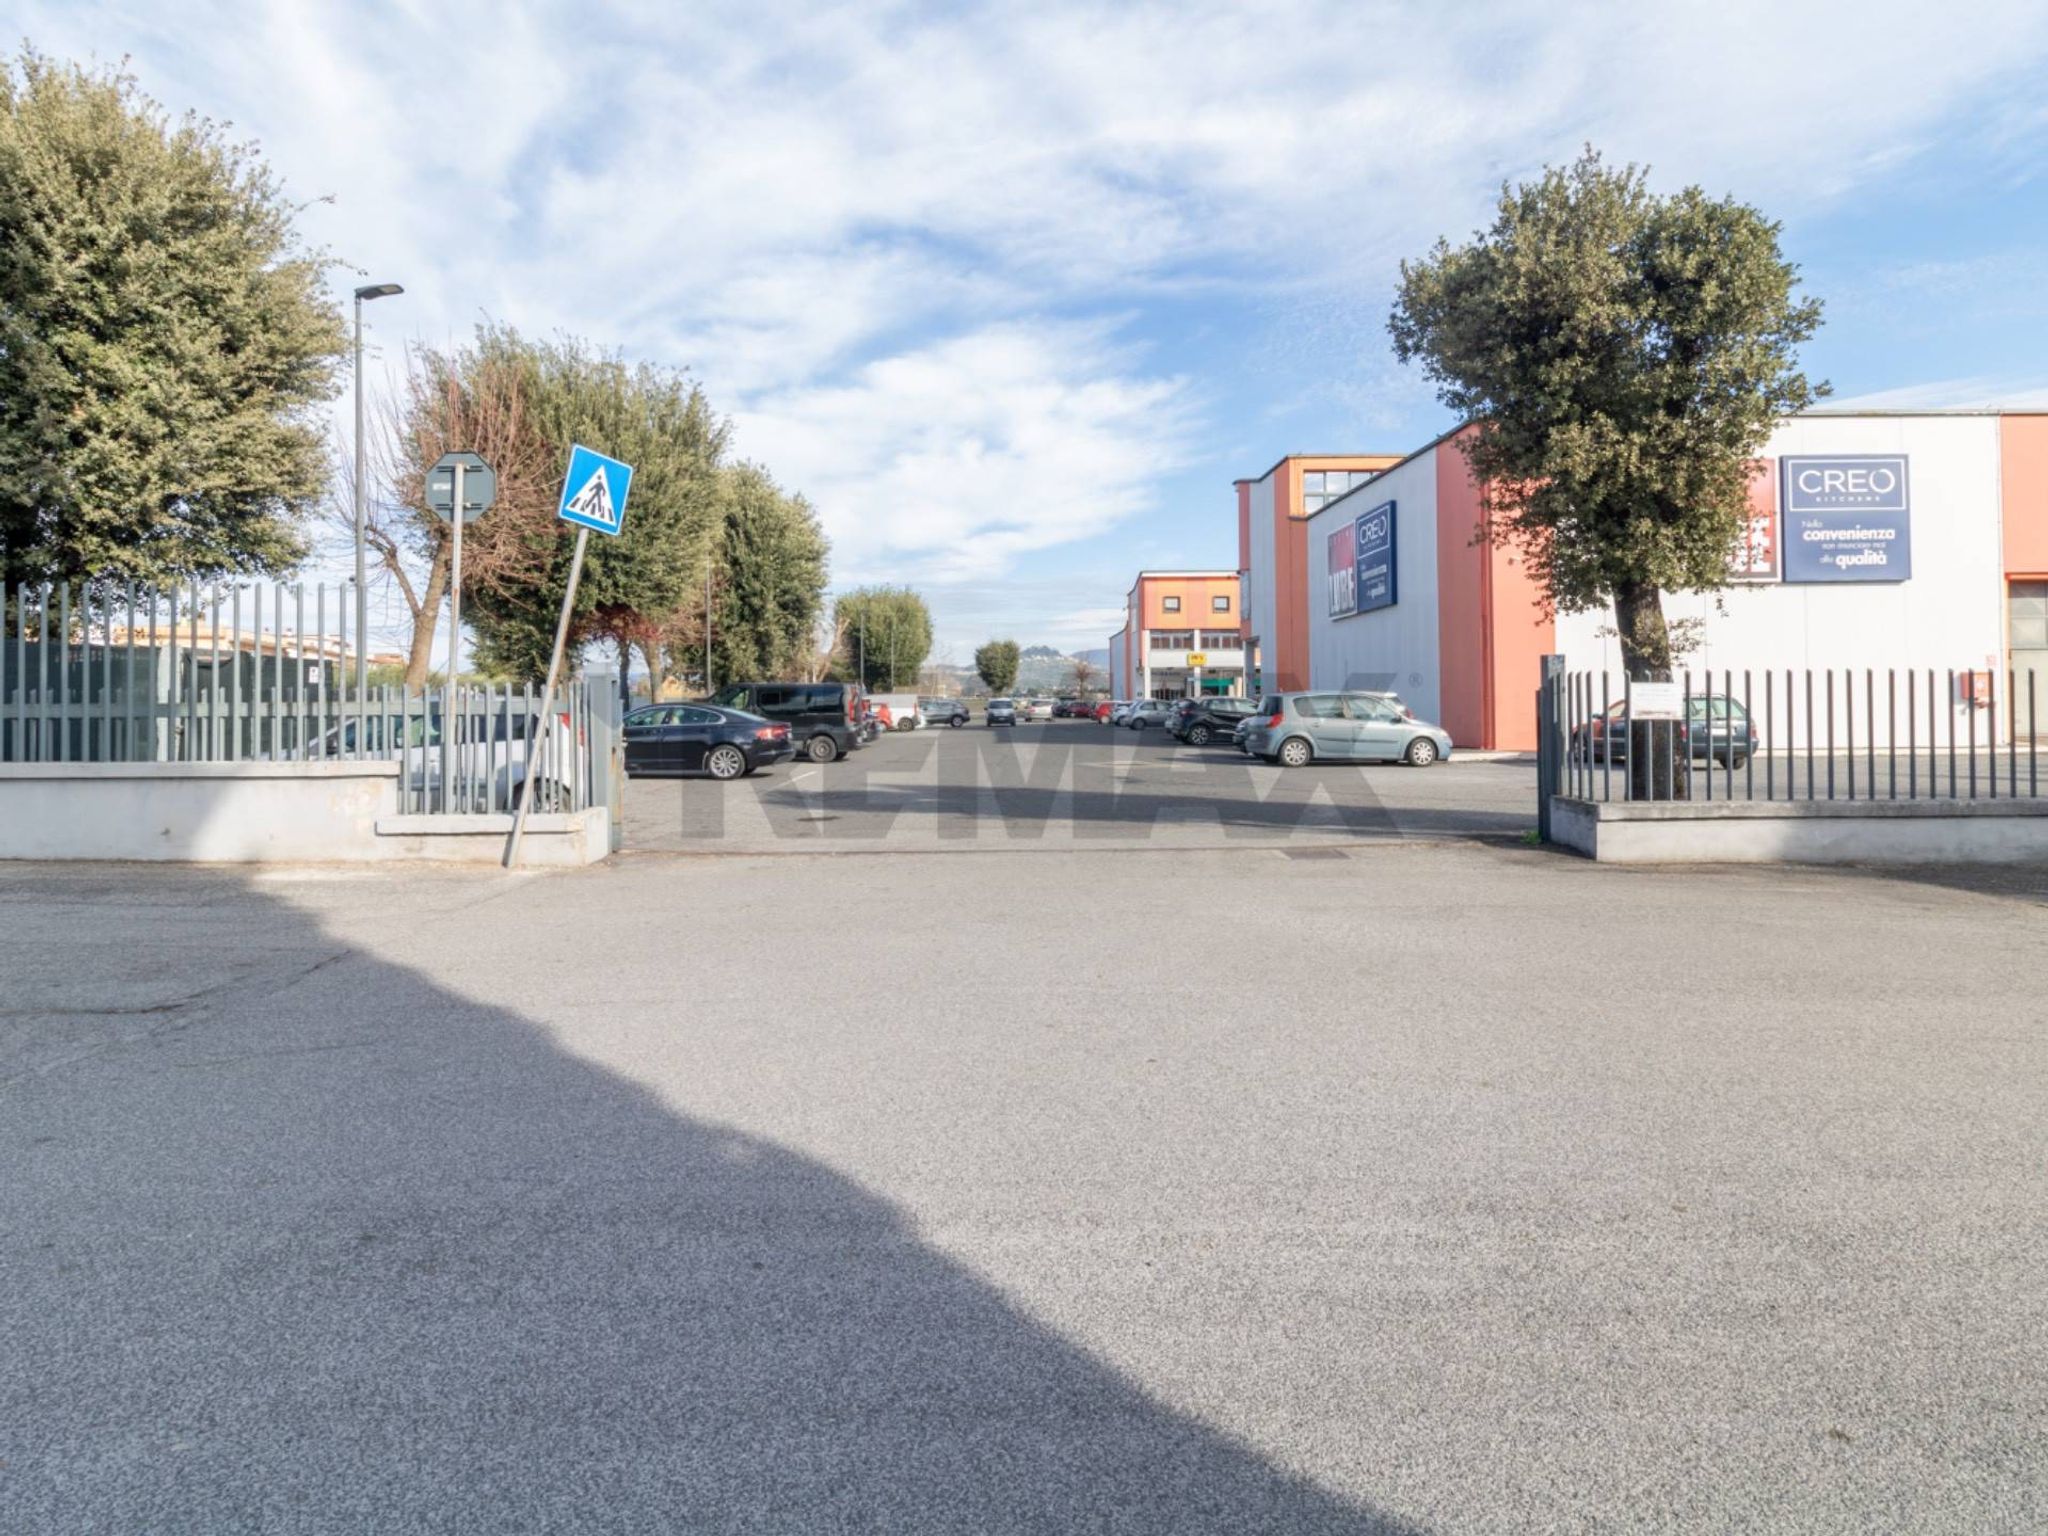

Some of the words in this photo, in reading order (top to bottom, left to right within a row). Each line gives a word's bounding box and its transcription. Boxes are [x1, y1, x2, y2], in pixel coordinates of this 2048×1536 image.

[1799, 469, 1895, 493] CREO
[1360, 516, 1386, 543] CREO
[1803, 525, 1895, 541] convenienza
[1835, 550, 1887, 569] qualità
